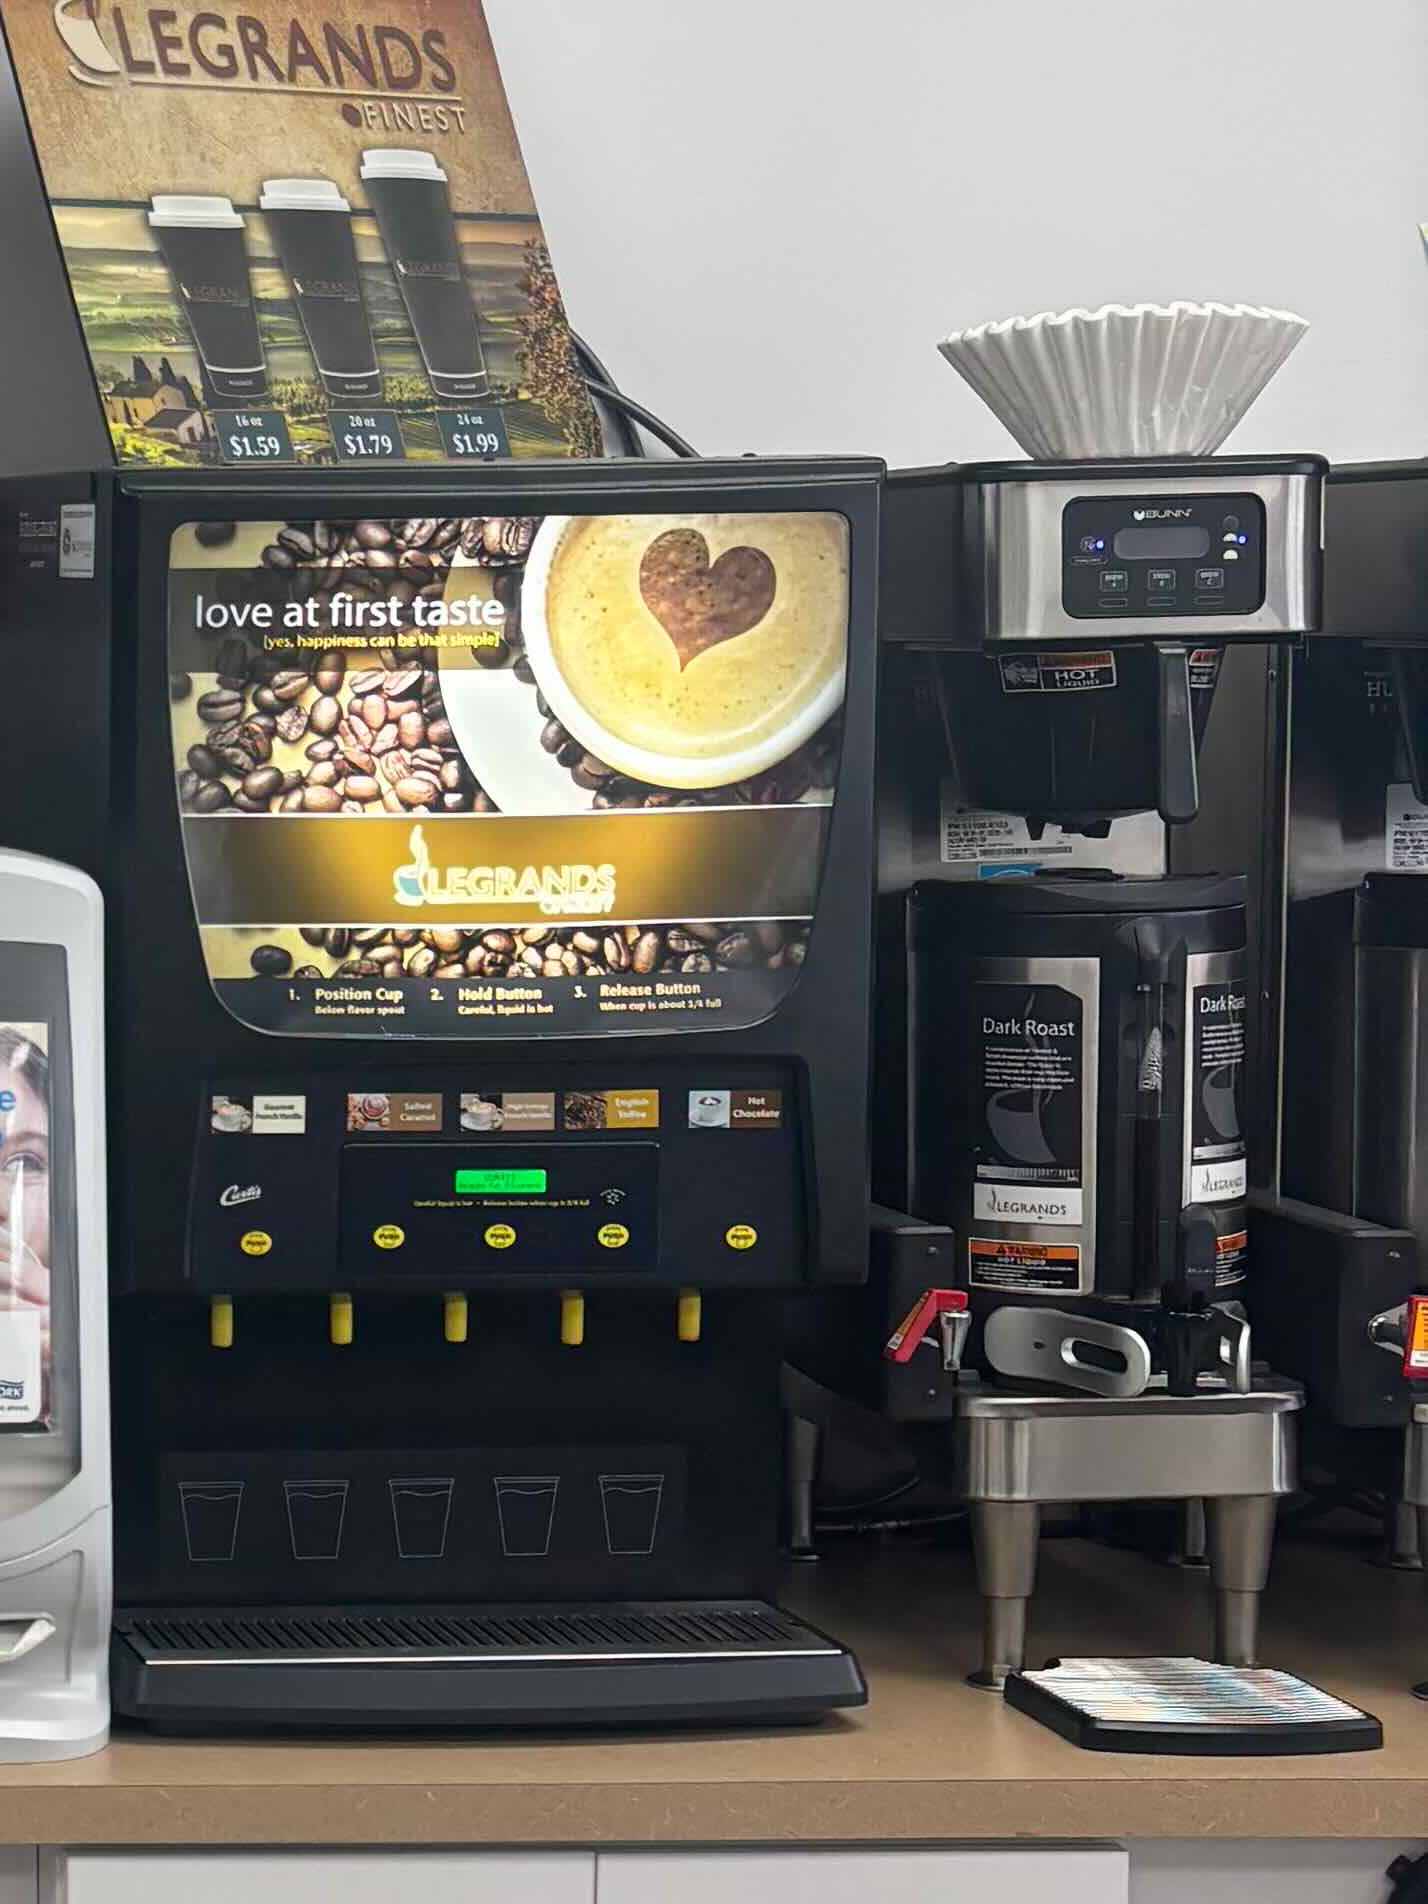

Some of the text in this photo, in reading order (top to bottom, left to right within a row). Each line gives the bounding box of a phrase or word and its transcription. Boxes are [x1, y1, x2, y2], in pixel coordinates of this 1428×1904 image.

[113, 7, 456, 91] LEGRANDS
[362, 100, 467, 134] FINEST
[229, 436, 281, 457] $1.59
[345, 435, 392, 456] $1.79
[454, 433, 499, 454] $1.99
[195, 592, 504, 629] love at first taste
[297, 634, 367, 649] happiness
[370, 636, 394, 647] can
[398, 633, 415, 646] be
[417, 633, 449, 647] that
[1055, 670, 1099, 680] HOT
[427, 864, 615, 897] LEGRANDS
[289, 988, 404, 1003] 1. Position Cup
[430, 987, 542, 1000] 2. Hold Button
[574, 983, 701, 998] 3. Release Button
[1200, 996, 1226, 1013] Dark
[983, 1018, 1075, 1036] Dark Roast
[748, 1096, 765, 1105] Hot
[732, 1108, 781, 1118] Chocolate
[997, 1201, 1067, 1216] LEGRANDS
